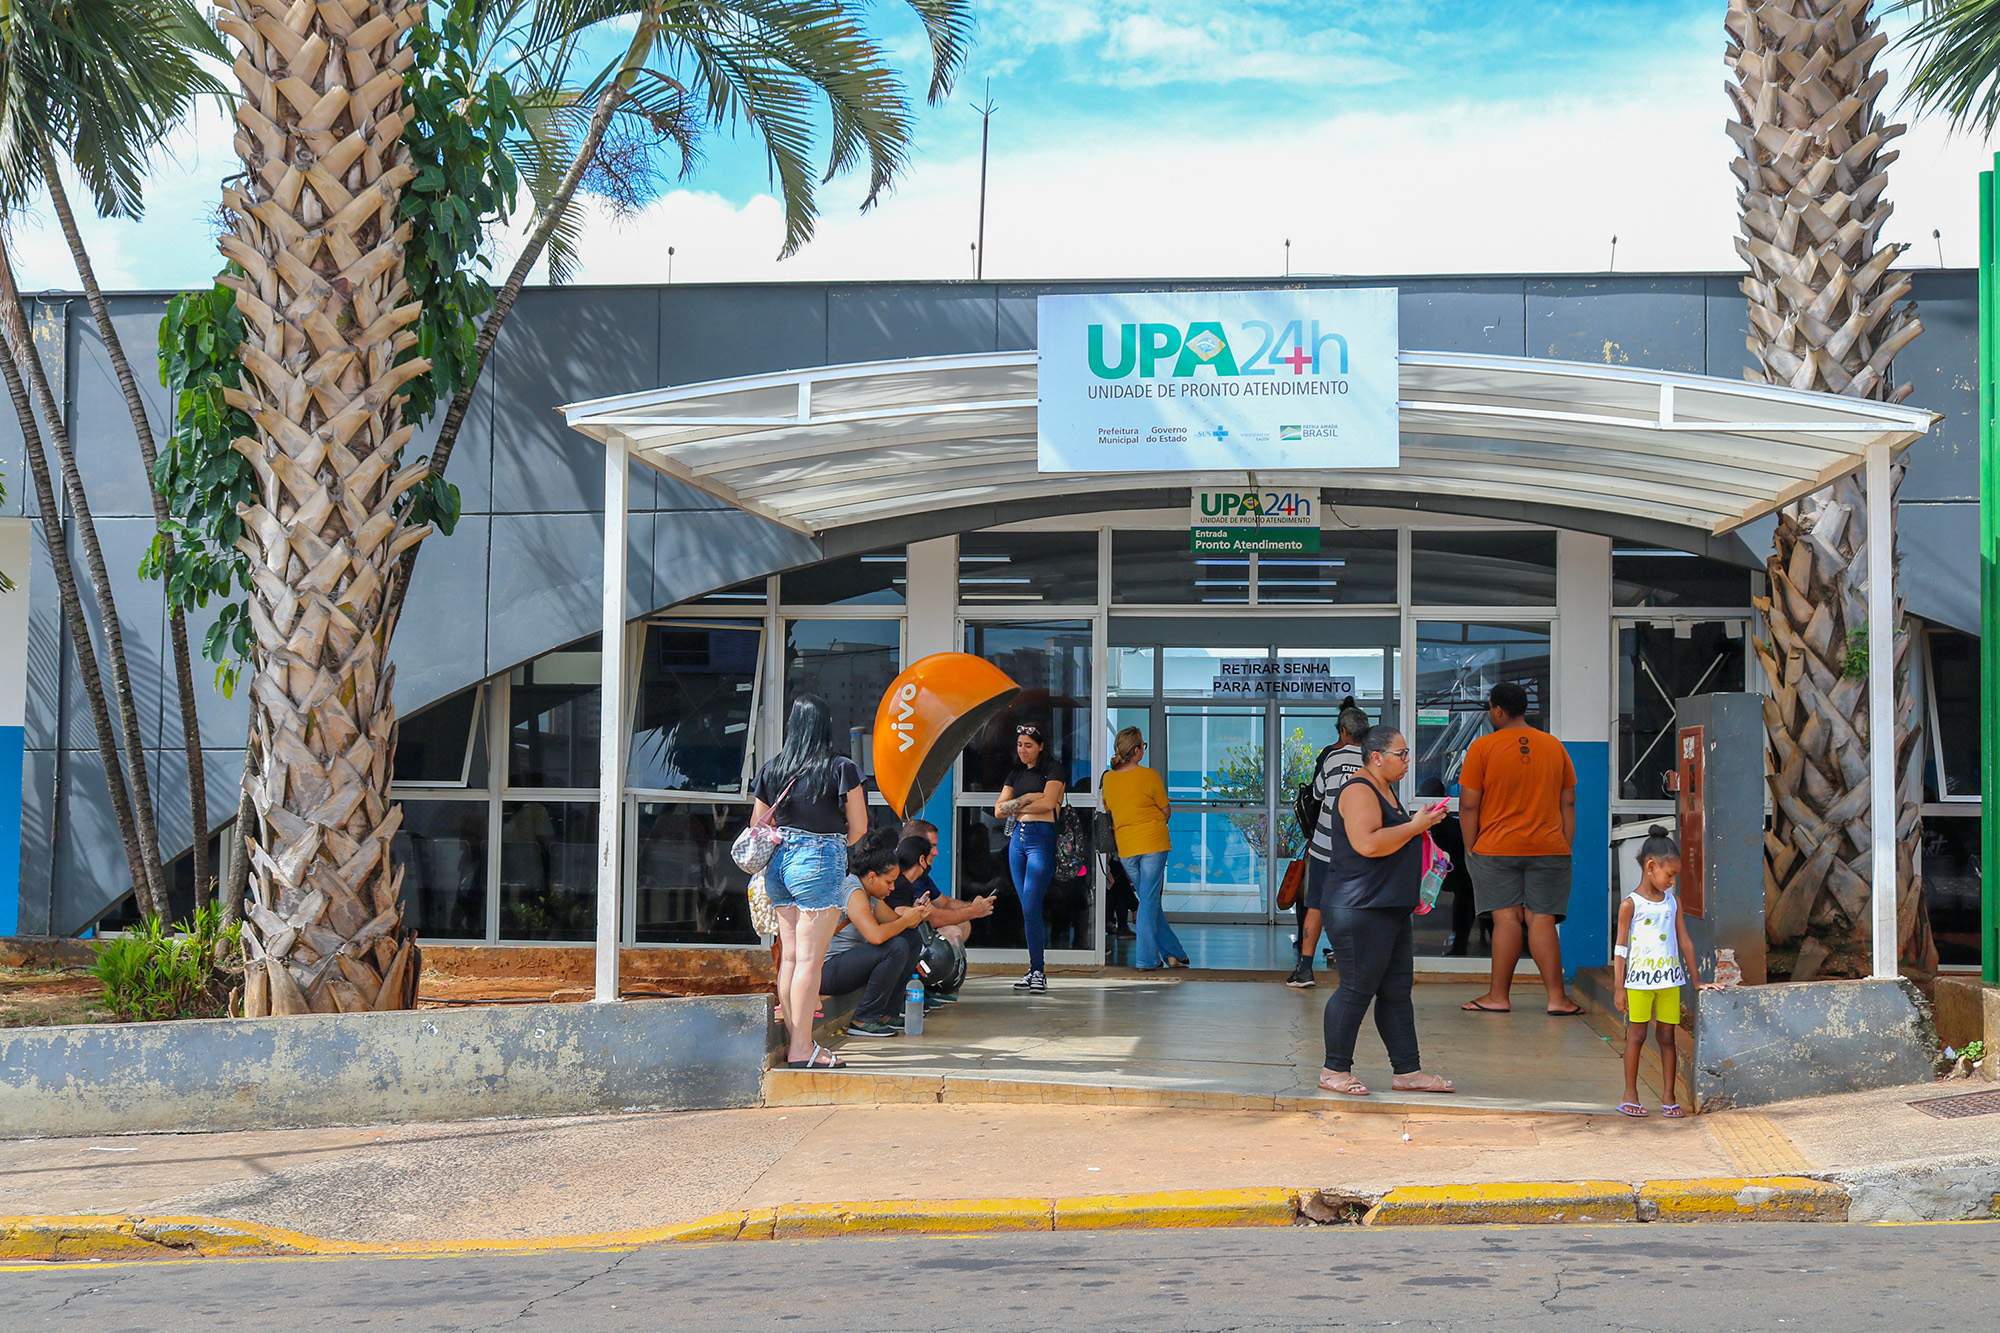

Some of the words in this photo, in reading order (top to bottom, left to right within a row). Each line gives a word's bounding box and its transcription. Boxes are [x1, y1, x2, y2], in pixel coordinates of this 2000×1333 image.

[1088, 384, 1152, 399] UNIDADE
[1157, 383, 1176, 398] DE
[1181, 382, 1240, 397] PRONTO
[1243, 380, 1349, 396] ATENDIMENTO
[1098, 427, 1139, 435] Prefeitura
[1151, 426, 1187, 434] Governo
[1302, 429, 1338, 438] BRASIL
[1098, 436, 1139, 445] Municipal
[1146, 435, 1157, 443] do
[1159, 435, 1187, 443] Estado
[1195, 530, 1228, 538] Entrada
[1195, 540, 1231, 549] Pronto
[1233, 540, 1303, 550] Atendimento
[1222, 664, 1281, 674] RETIRAR
[1283, 663, 1330, 674] SENHA
[1213, 681, 1251, 692] PARA
[1254, 681, 1352, 693] ATENDIMENTO
[891, 683, 917, 753] vivo
